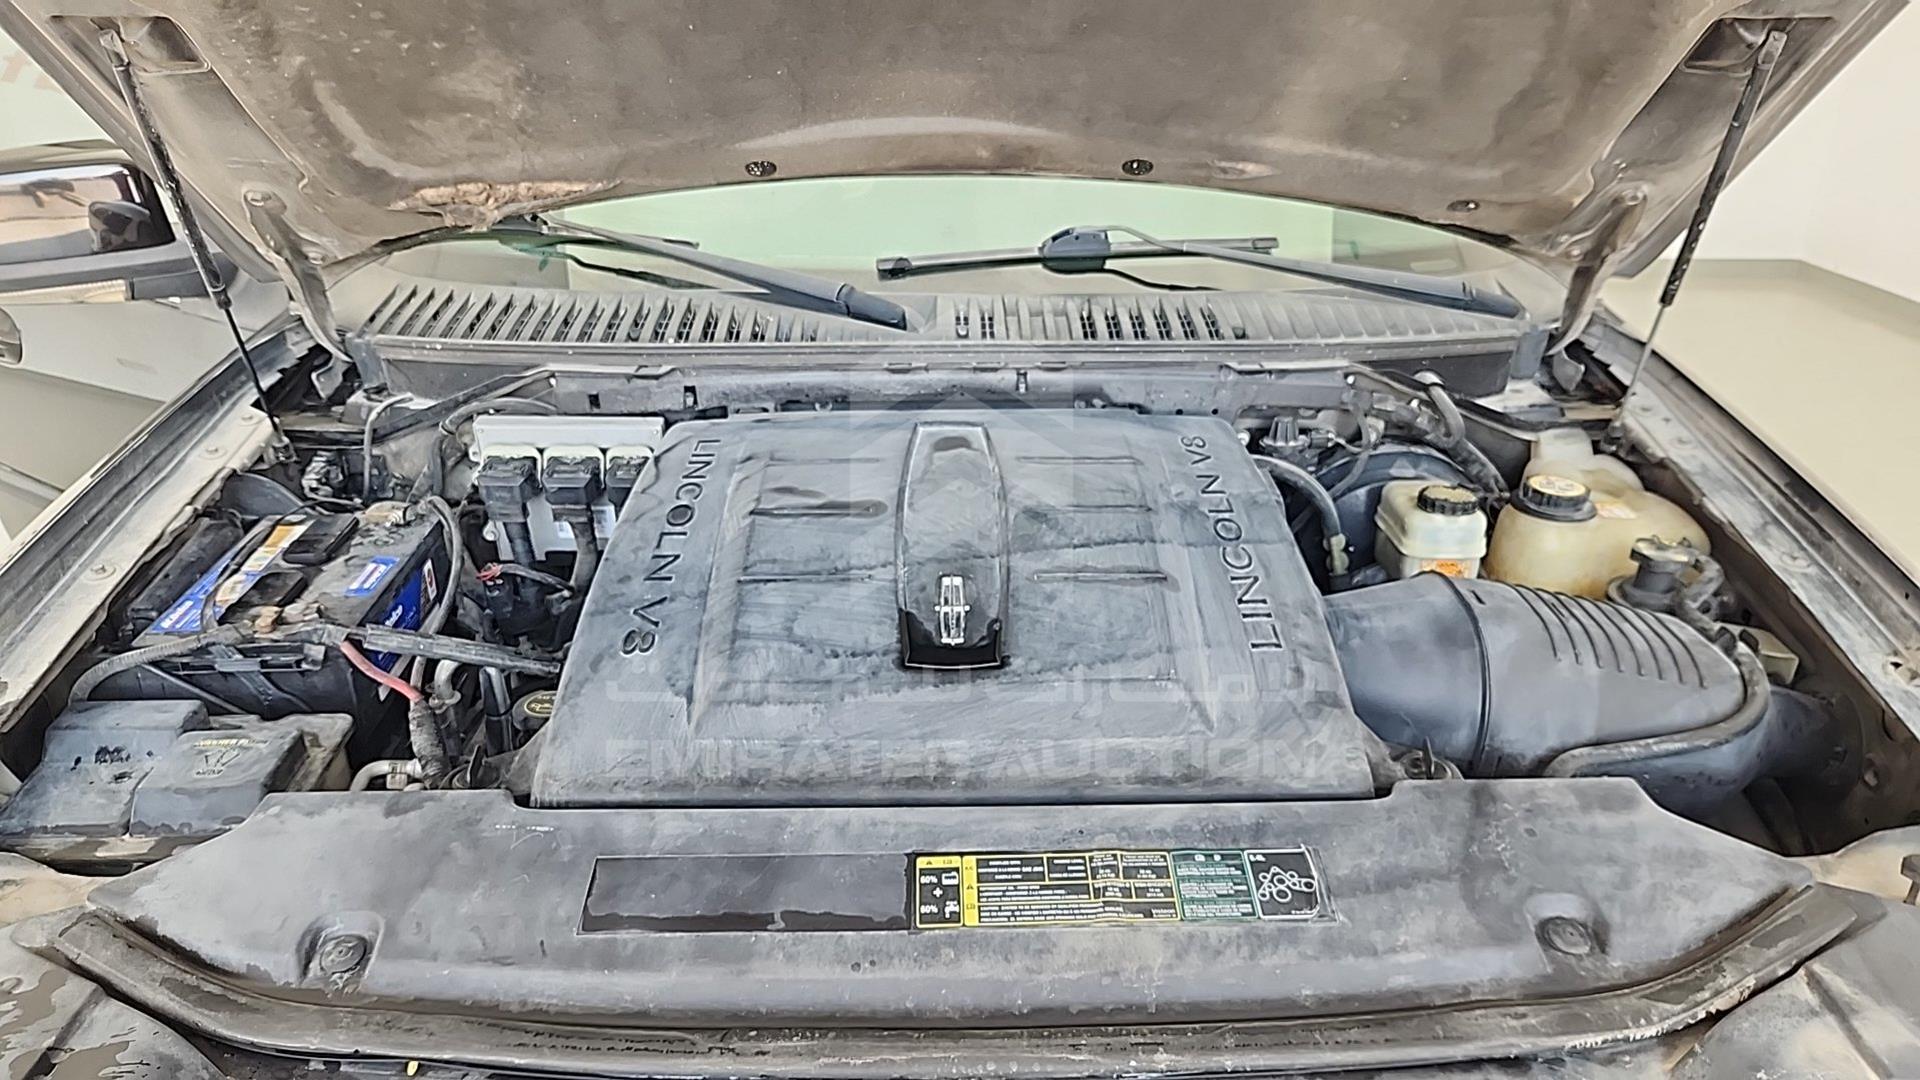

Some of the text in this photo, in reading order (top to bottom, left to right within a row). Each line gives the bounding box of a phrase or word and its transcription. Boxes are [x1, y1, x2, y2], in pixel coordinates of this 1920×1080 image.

[621, 439, 722, 655] LINCOLN V8
[1180, 435, 1283, 649] LINCOLN V8
